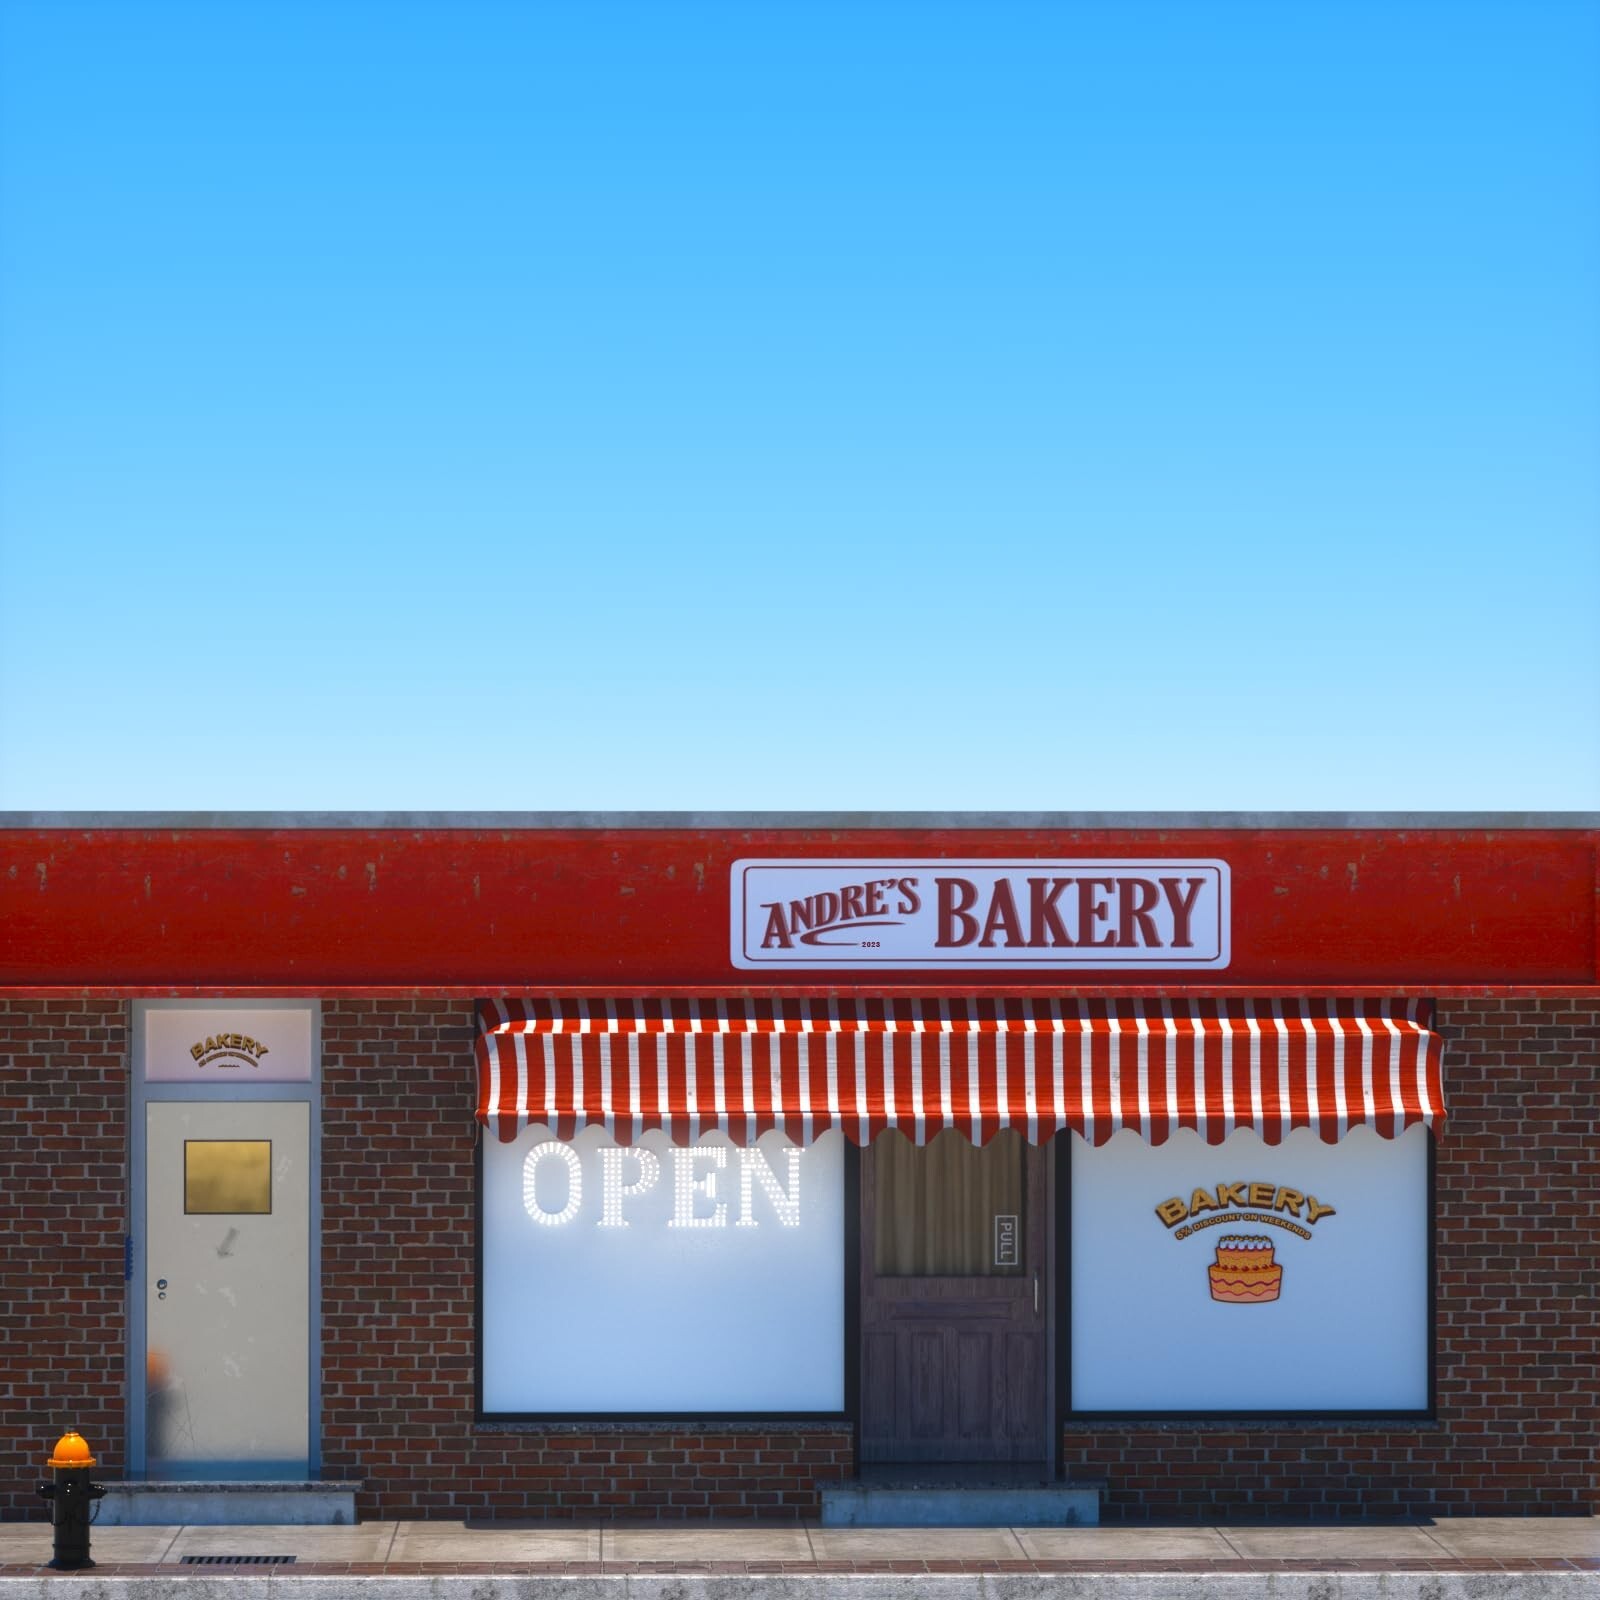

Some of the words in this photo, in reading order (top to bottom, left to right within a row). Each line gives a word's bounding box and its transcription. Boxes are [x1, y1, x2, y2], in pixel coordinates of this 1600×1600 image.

[760, 877, 921, 948] ANDRE'S
[934, 877, 1207, 948] BAKERY
[190, 1033, 269, 1061] BAKERY
[523, 1141, 806, 1227] OPEN
[1155, 1181, 1336, 1229] BAKERY
[1000, 1222, 1012, 1259] PULL
[1192, 1213, 1241, 1232] DISCOUNT
[1242, 1213, 1259, 1221] ON
[1260, 1214, 1311, 1240] WEEKENDS
